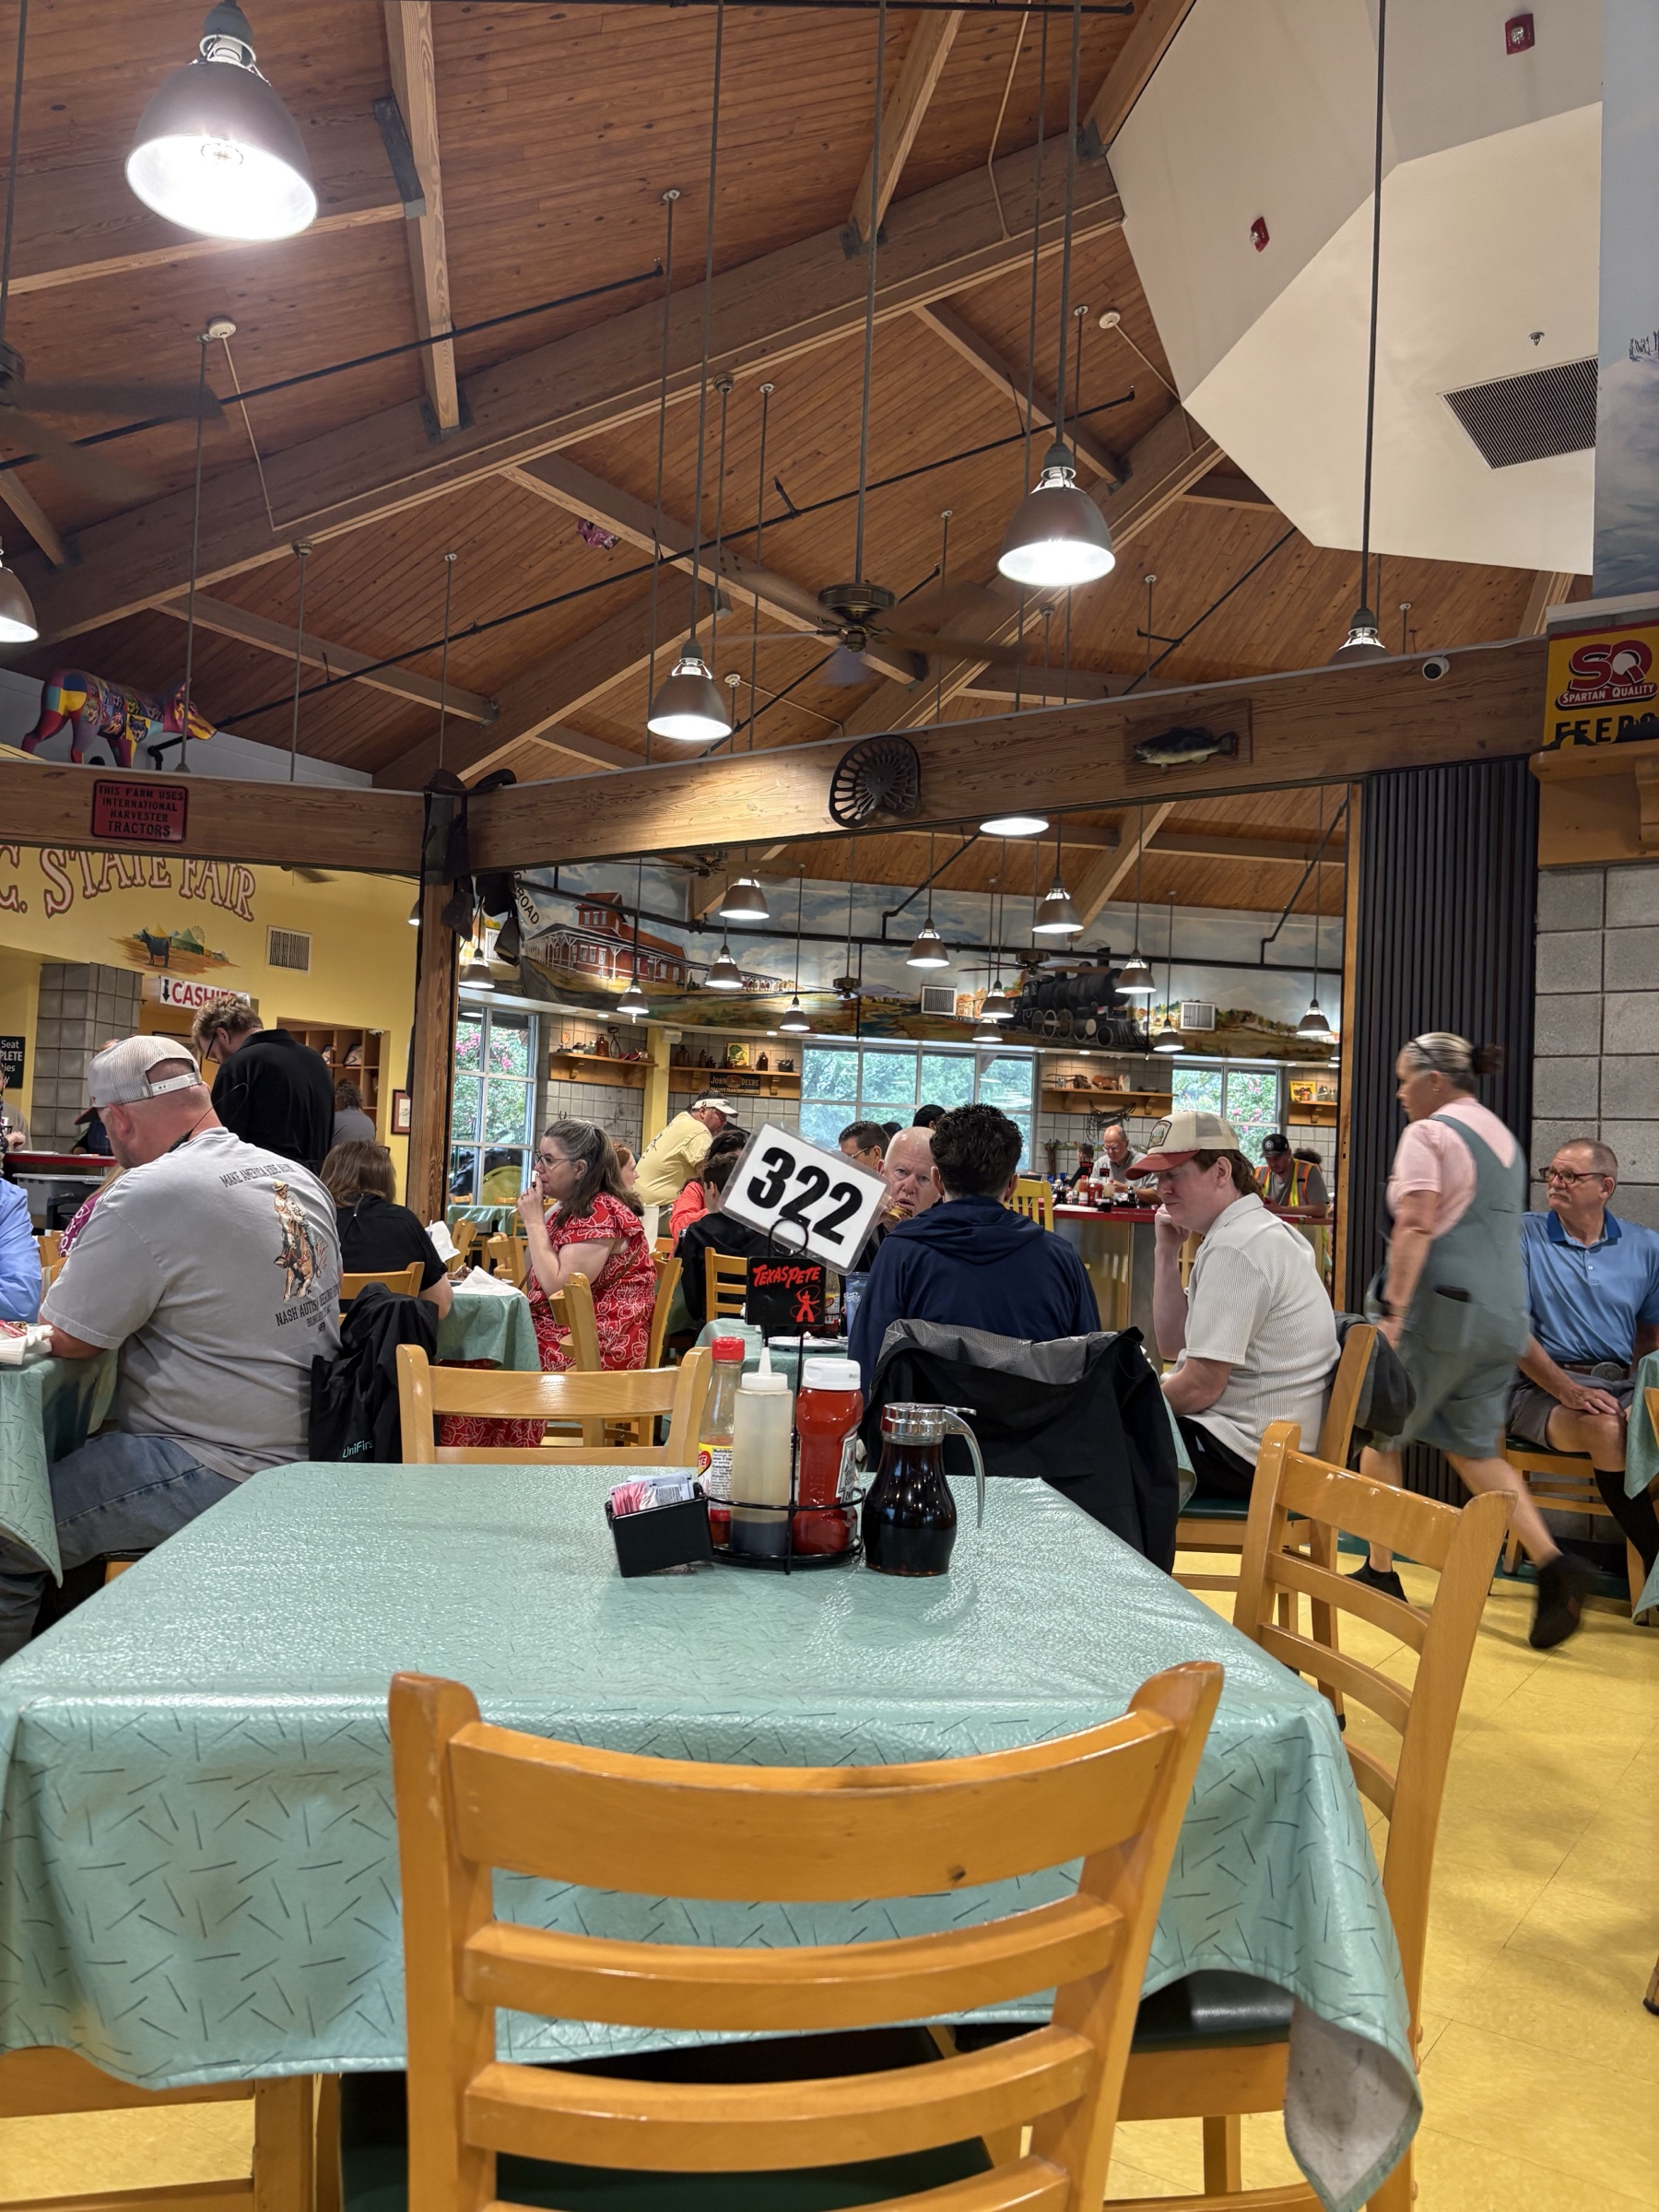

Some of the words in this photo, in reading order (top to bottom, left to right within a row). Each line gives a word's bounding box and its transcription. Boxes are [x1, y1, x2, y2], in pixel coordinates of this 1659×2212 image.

[1569, 640, 1653, 691] SQ
[1562, 689, 1606, 704] SPARTAN
[1612, 683, 1655, 699] QUALITY
[98, 785, 121, 795] THIS
[125, 787, 154, 799] FARM
[159, 790, 184, 801] USES
[102, 797, 178, 812] INTERNATIONAL
[110, 810, 169, 823] HARVESTER
[108, 819, 171, 838] TRACTORS
[179, 858, 256, 923] FAIR
[171, 982, 238, 1007] CASH
[1, 1040, 20, 1050] Seat
[711, 1077, 726, 1085] JOHN
[218, 1171, 244, 1188] MAKE
[747, 1147, 863, 1246] 322
[275, 1306, 299, 1327] NASH
